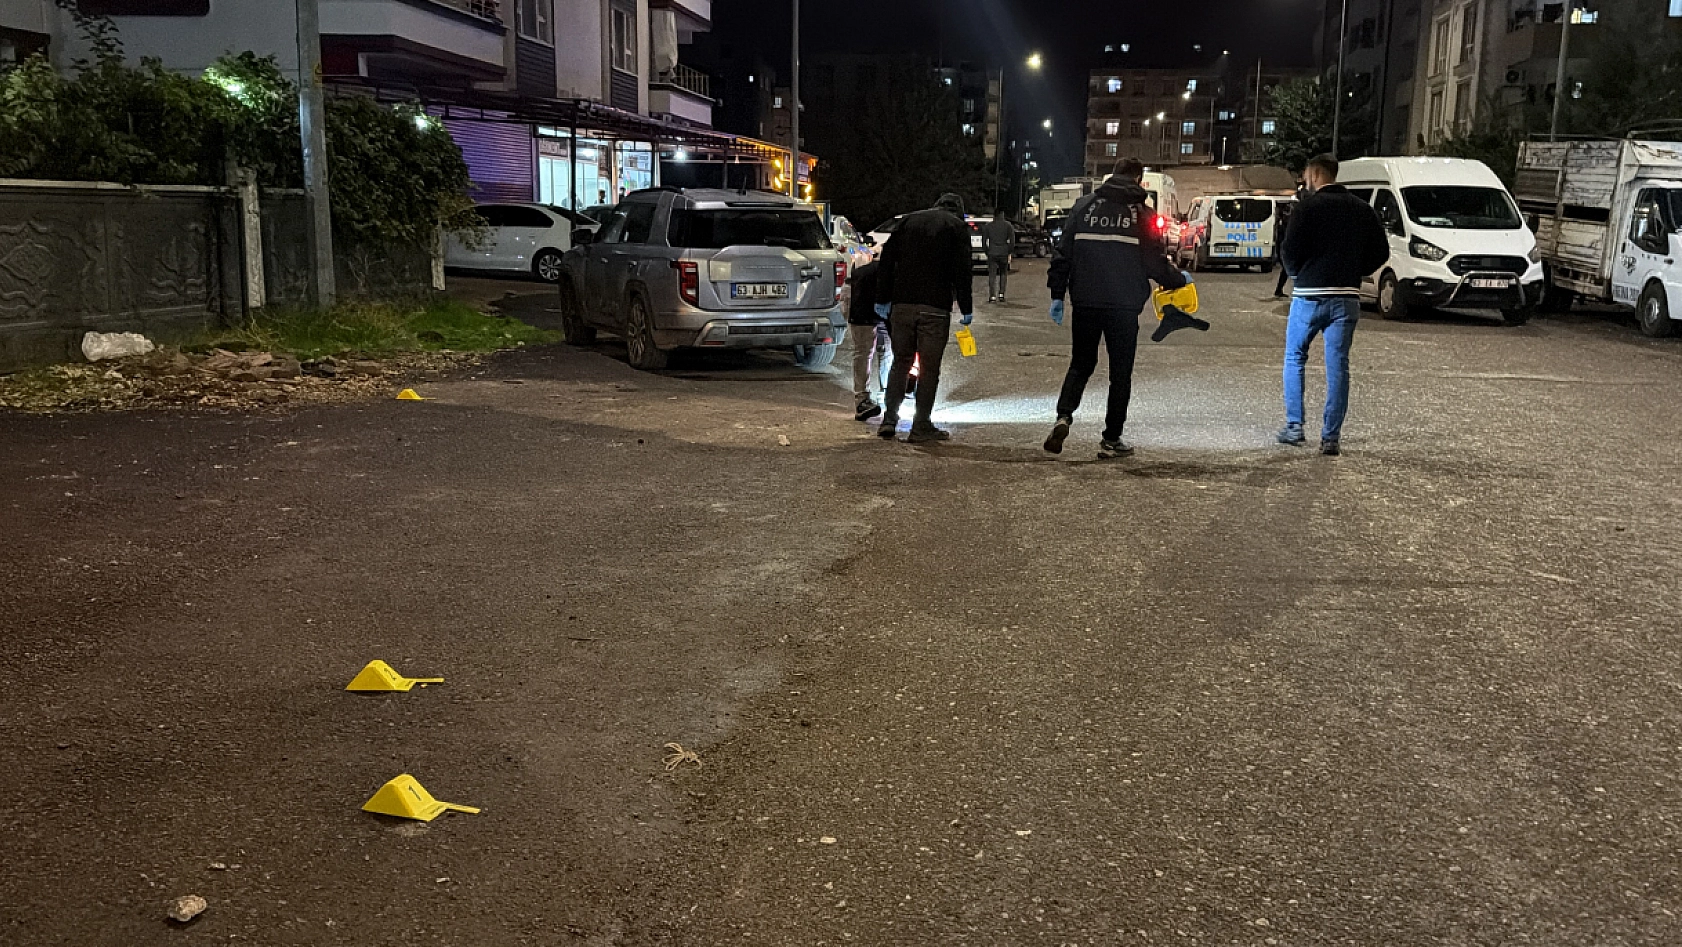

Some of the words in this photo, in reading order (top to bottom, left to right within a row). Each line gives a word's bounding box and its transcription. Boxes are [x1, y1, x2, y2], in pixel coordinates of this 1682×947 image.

[1090, 213, 1131, 229] POLİS
[737, 285, 747, 294] 63
[752, 285, 767, 294] AJH
[771, 285, 787, 294] 482
[408, 784, 422, 801] 1
